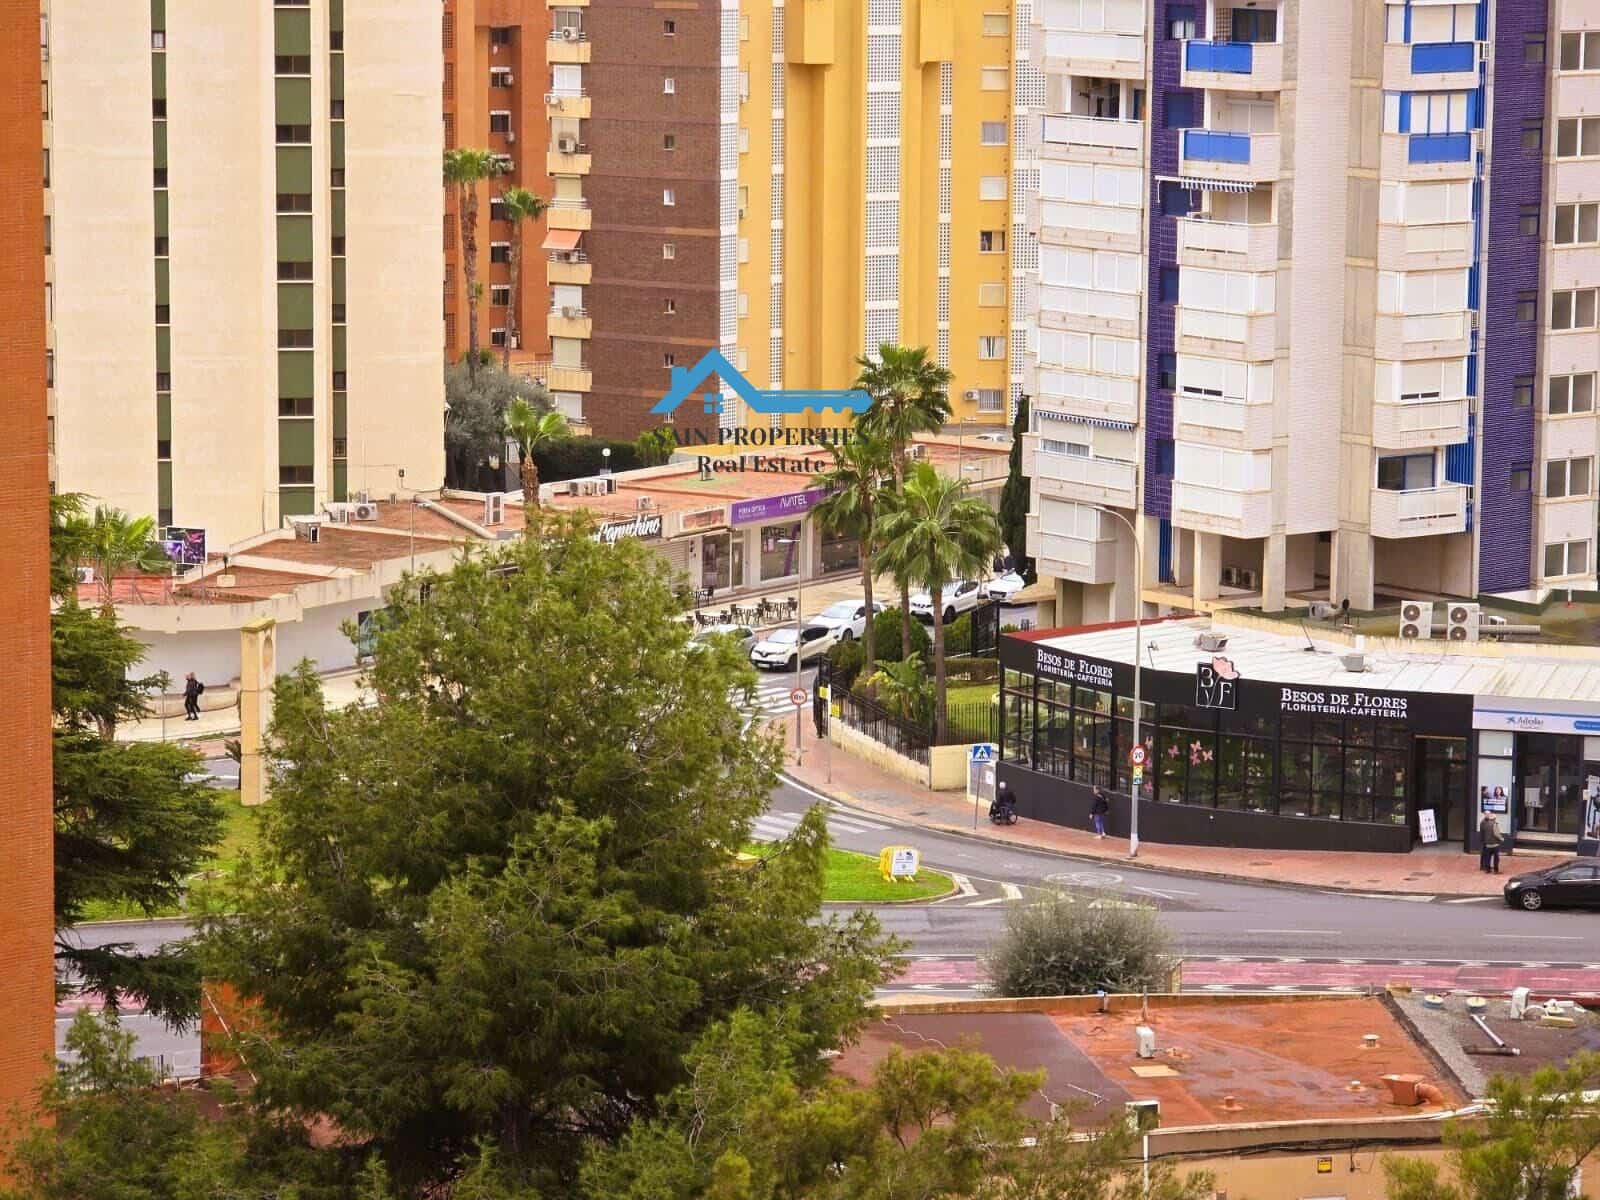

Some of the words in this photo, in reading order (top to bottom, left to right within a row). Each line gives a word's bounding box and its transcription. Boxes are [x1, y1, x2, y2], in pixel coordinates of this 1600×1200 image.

[1037, 649, 1062, 667] BESOS
[1064, 658, 1076, 671] DE
[1079, 659, 1113, 679] FLORES
[1281, 687, 1325, 704] BESOS
[1330, 693, 1350, 706] DE
[1353, 692, 1408, 710] FLORES
